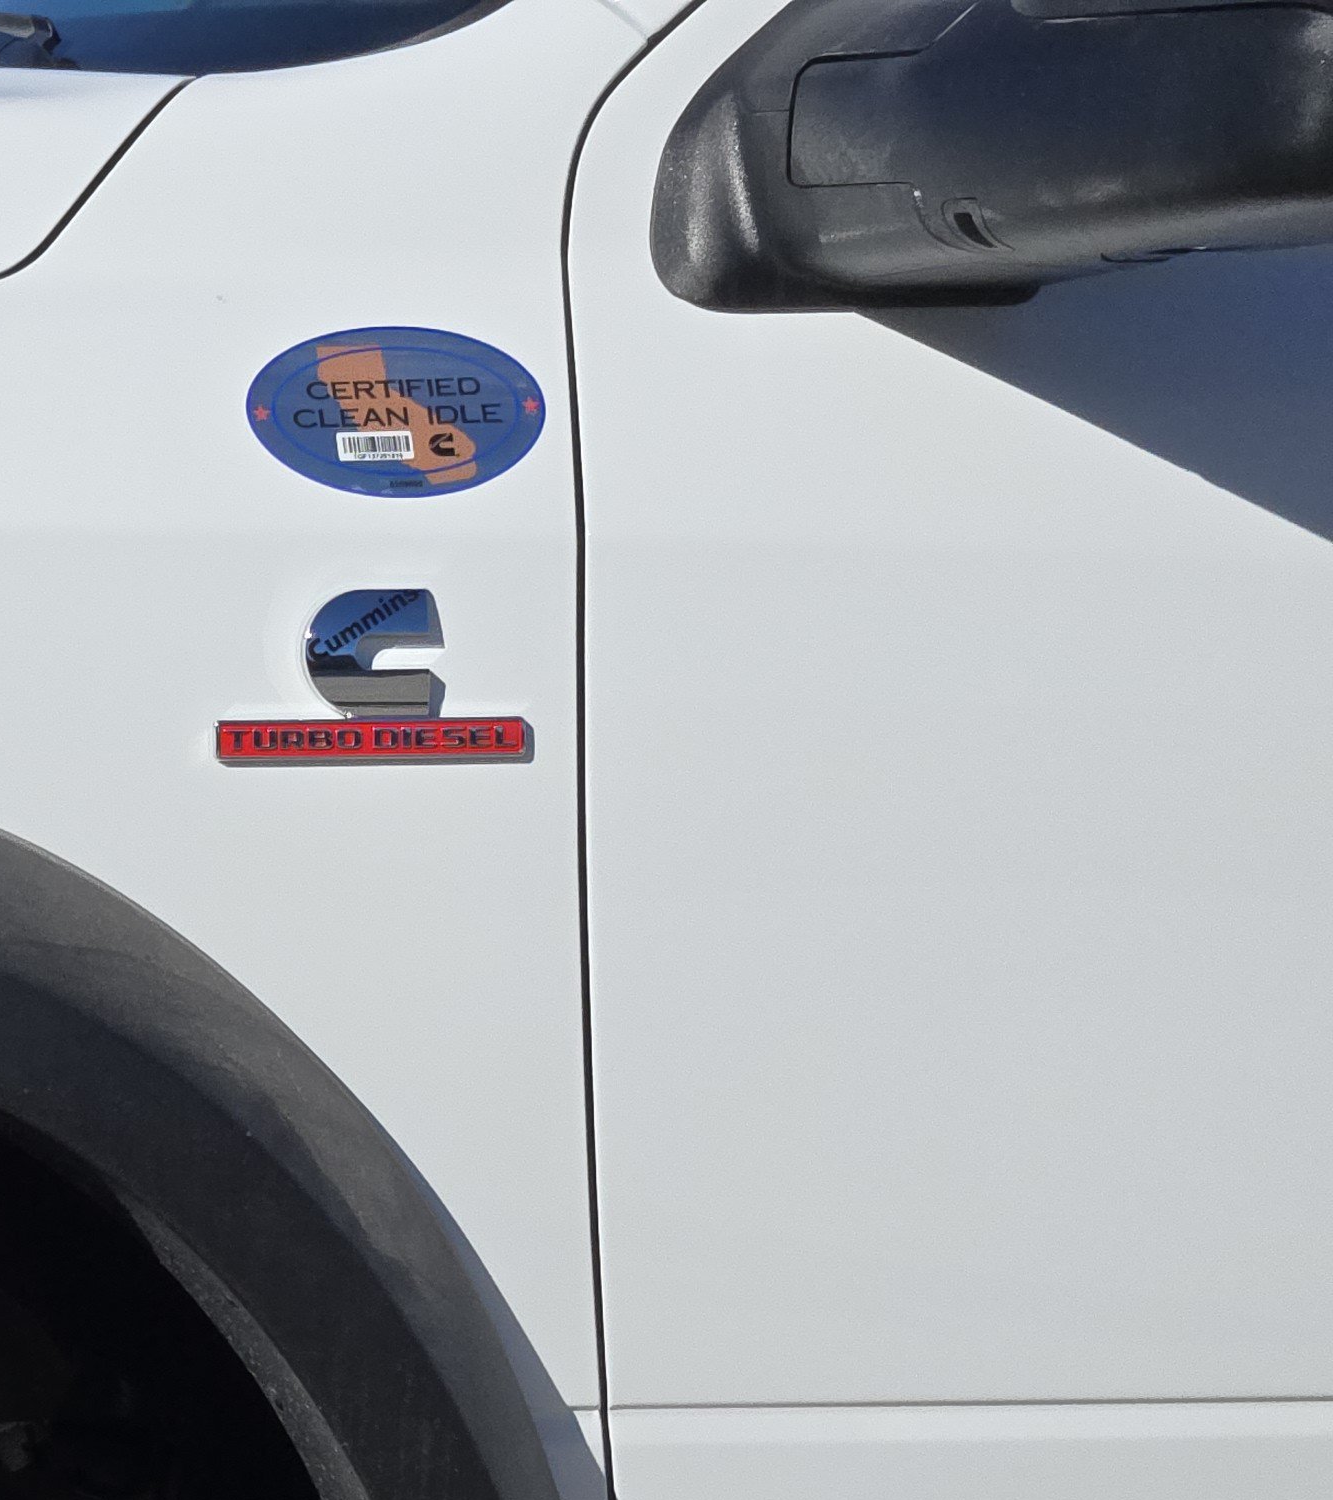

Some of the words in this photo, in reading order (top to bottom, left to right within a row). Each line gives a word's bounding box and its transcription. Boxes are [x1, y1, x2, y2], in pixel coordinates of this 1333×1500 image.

[305, 376, 480, 401] CERTIFIED
[293, 406, 409, 429] CLEAN
[427, 403, 503, 425] IDLE
[307, 589, 421, 661] Cummins
[222, 727, 363, 750] TURBO
[372, 725, 517, 750] DIESEL
